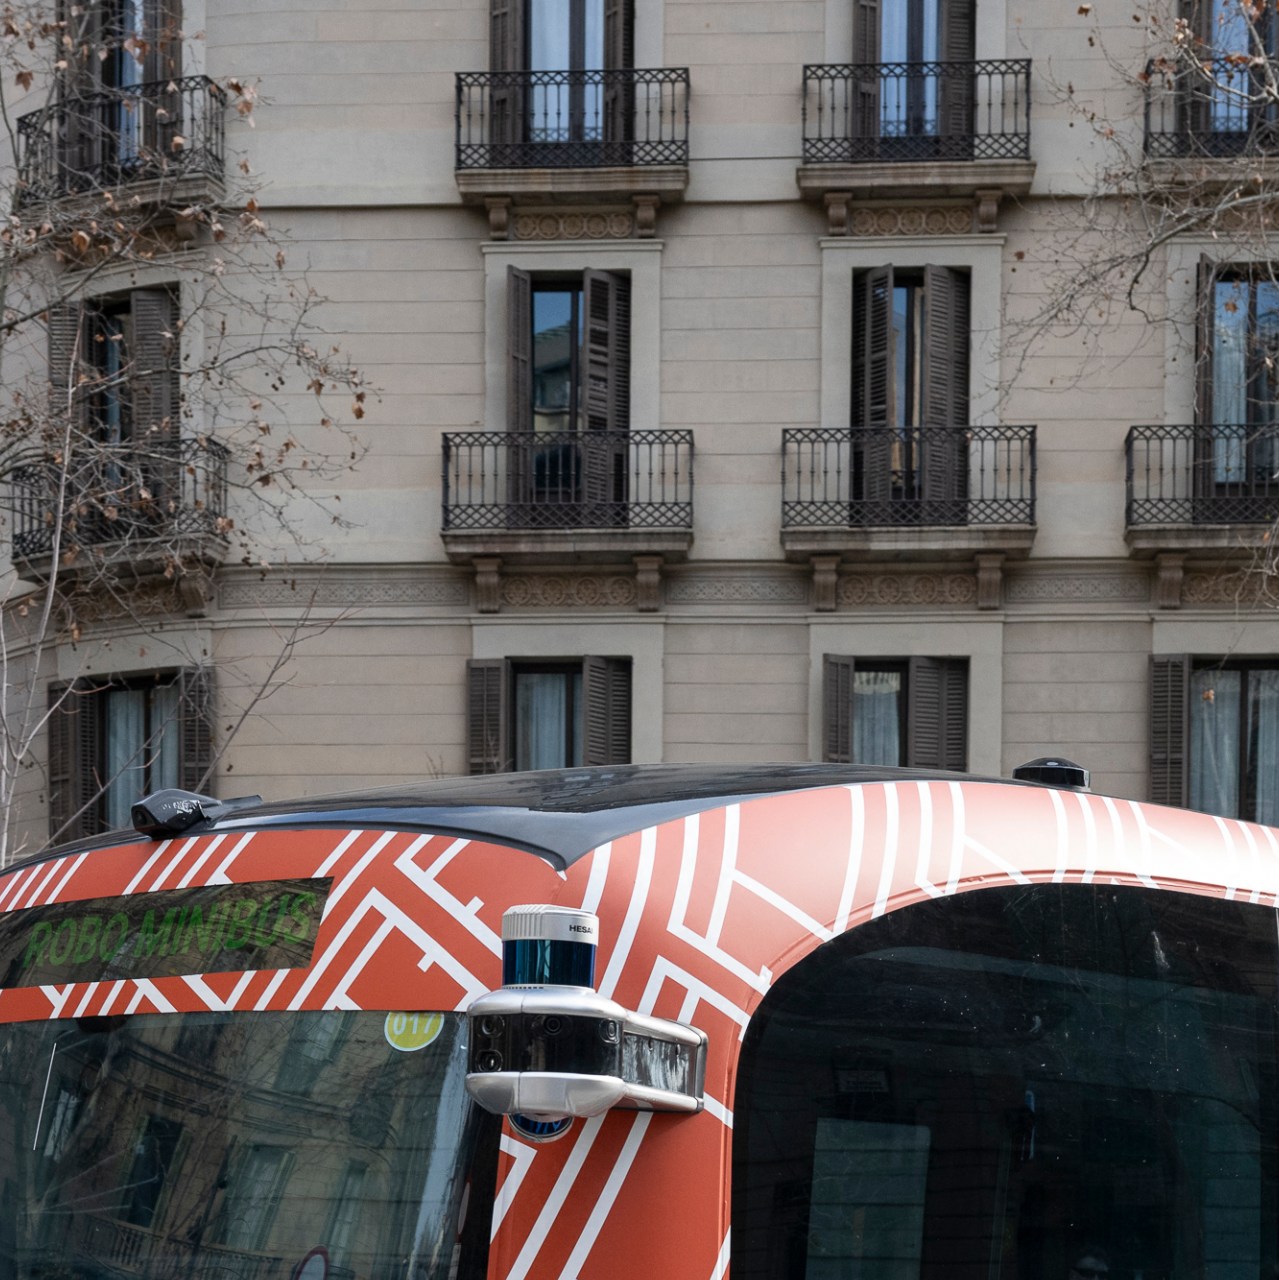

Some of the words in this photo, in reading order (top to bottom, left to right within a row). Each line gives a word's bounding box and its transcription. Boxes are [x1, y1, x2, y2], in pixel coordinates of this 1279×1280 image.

[23, 911, 129, 969] ROBO
[131, 891, 318, 958] MINIBUS
[568, 924, 593, 934] HESAI
[392, 1012, 437, 1036] 017
